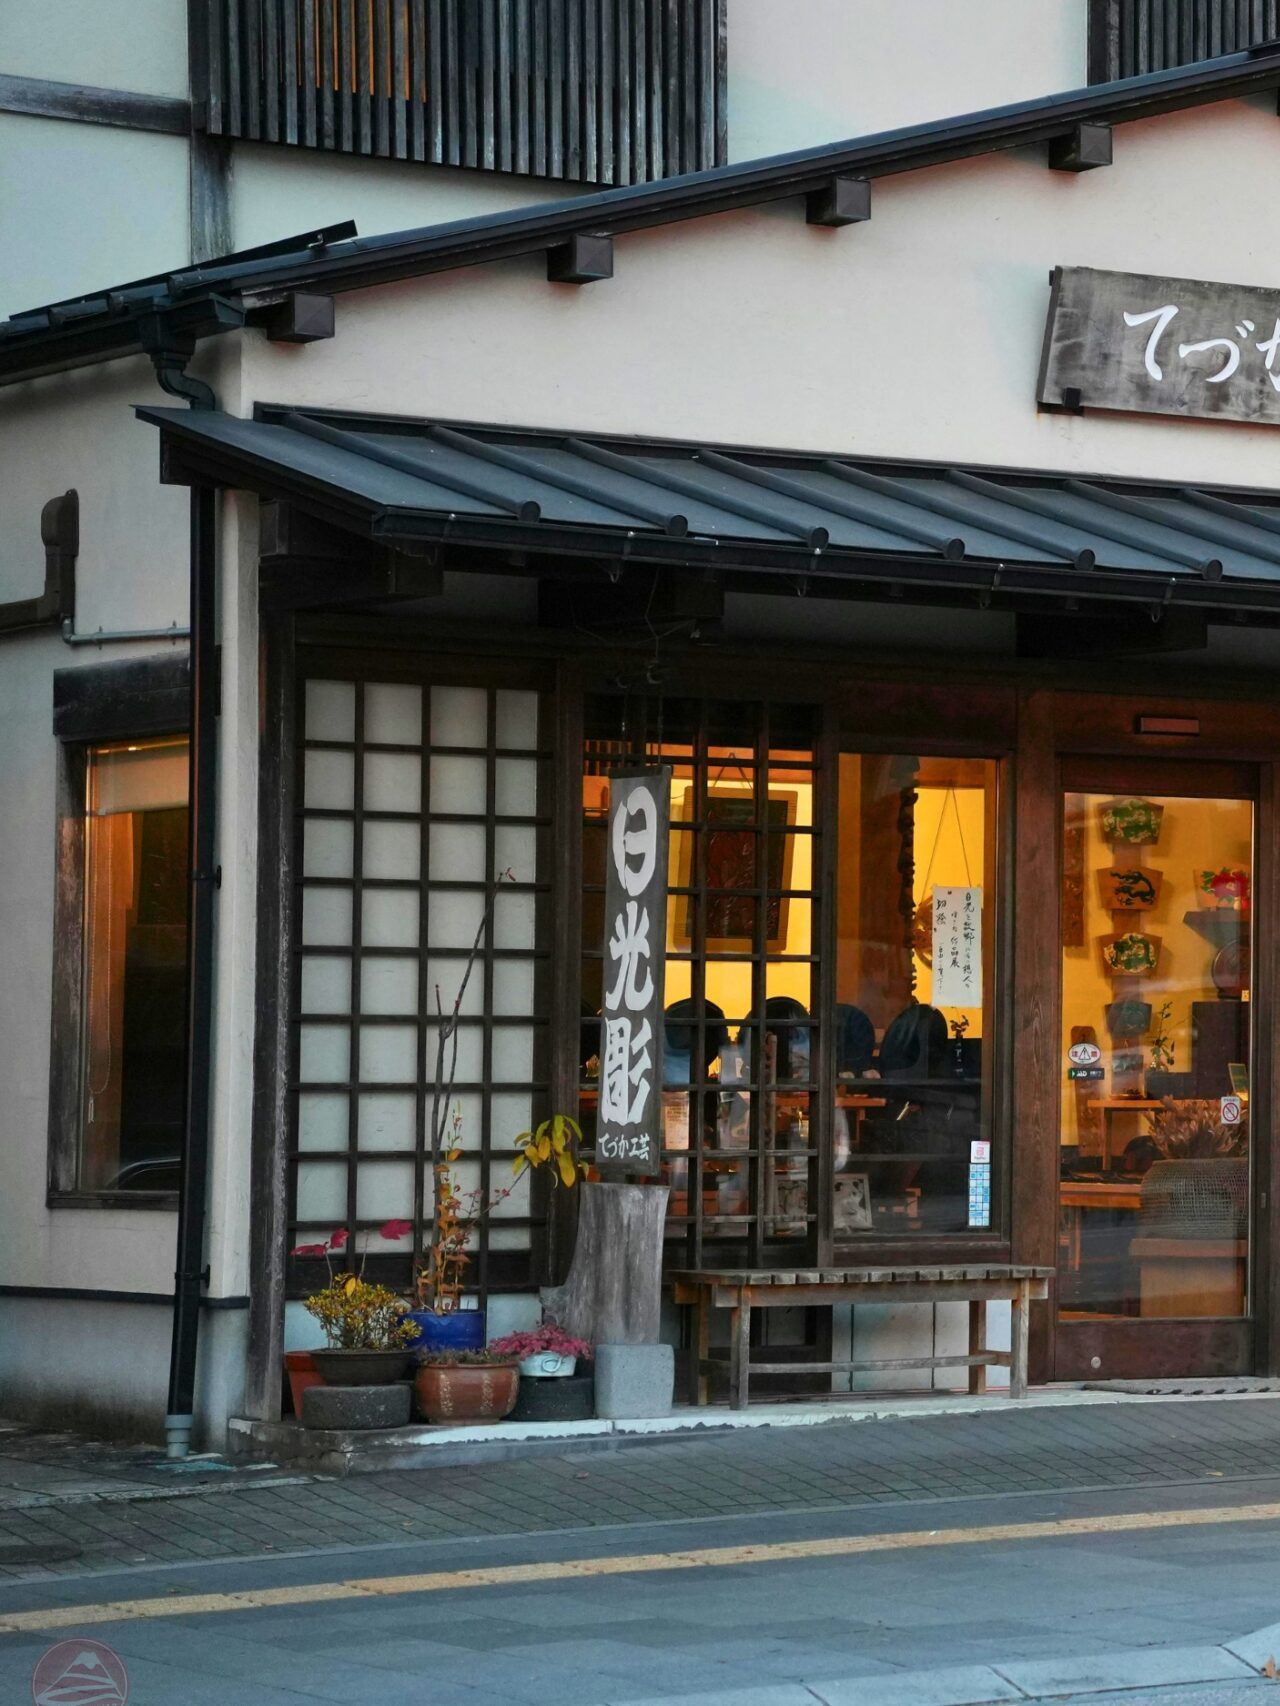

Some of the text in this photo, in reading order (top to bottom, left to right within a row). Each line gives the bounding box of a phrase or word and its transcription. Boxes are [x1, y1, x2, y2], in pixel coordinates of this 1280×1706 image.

[601, 785, 658, 1124] 日光彫
[598, 1131, 651, 1161] てづか工芸
